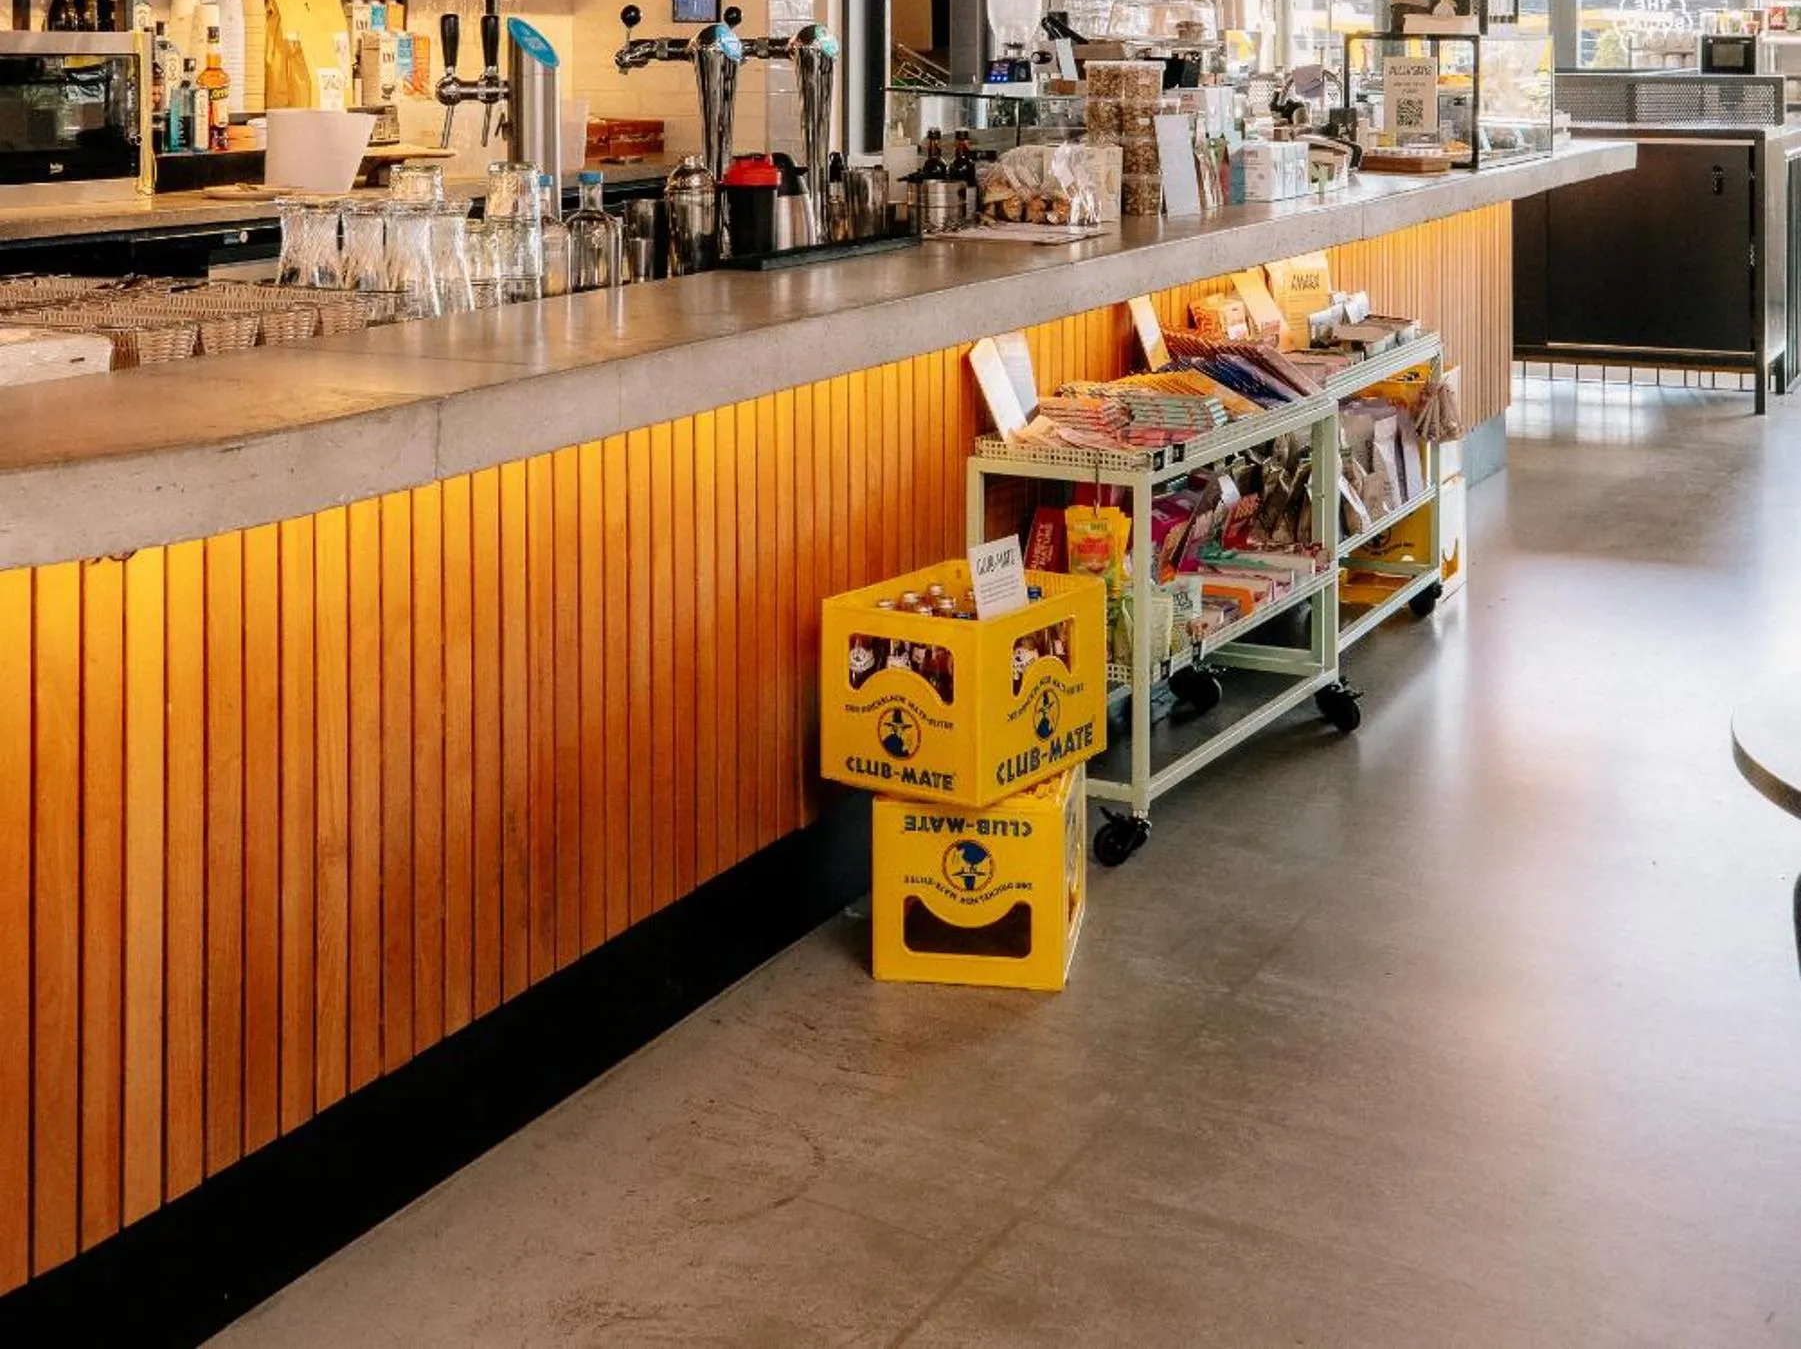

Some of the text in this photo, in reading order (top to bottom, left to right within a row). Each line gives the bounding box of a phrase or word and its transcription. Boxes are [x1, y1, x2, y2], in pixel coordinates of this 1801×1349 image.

[995, 721, 1093, 786] CLUB-MATE
[845, 755, 953, 791] CLUB-MATE
[903, 815, 1033, 838] CLUB-MATE
